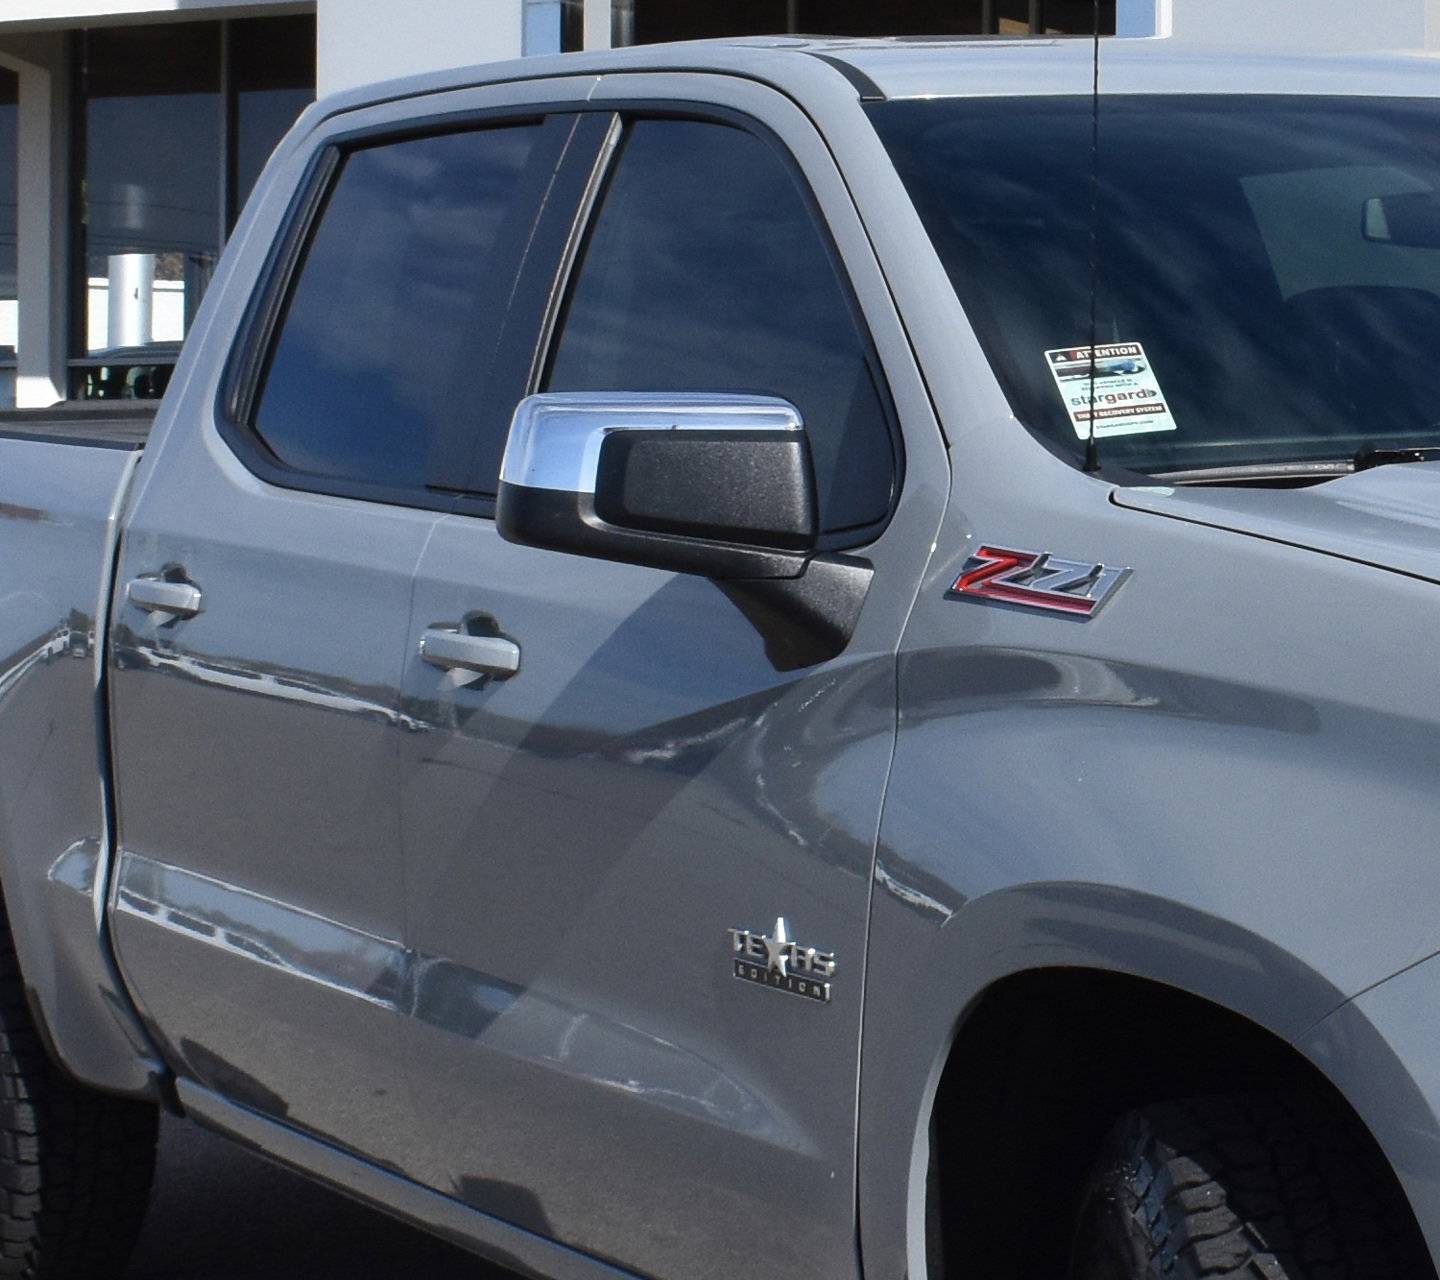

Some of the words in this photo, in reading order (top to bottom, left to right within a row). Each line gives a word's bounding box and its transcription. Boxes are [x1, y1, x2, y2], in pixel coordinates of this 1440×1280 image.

[1076, 346, 1137, 359] ATENTION
[949, 543, 1133, 619] Z71
[738, 963, 822, 997] EDITION
